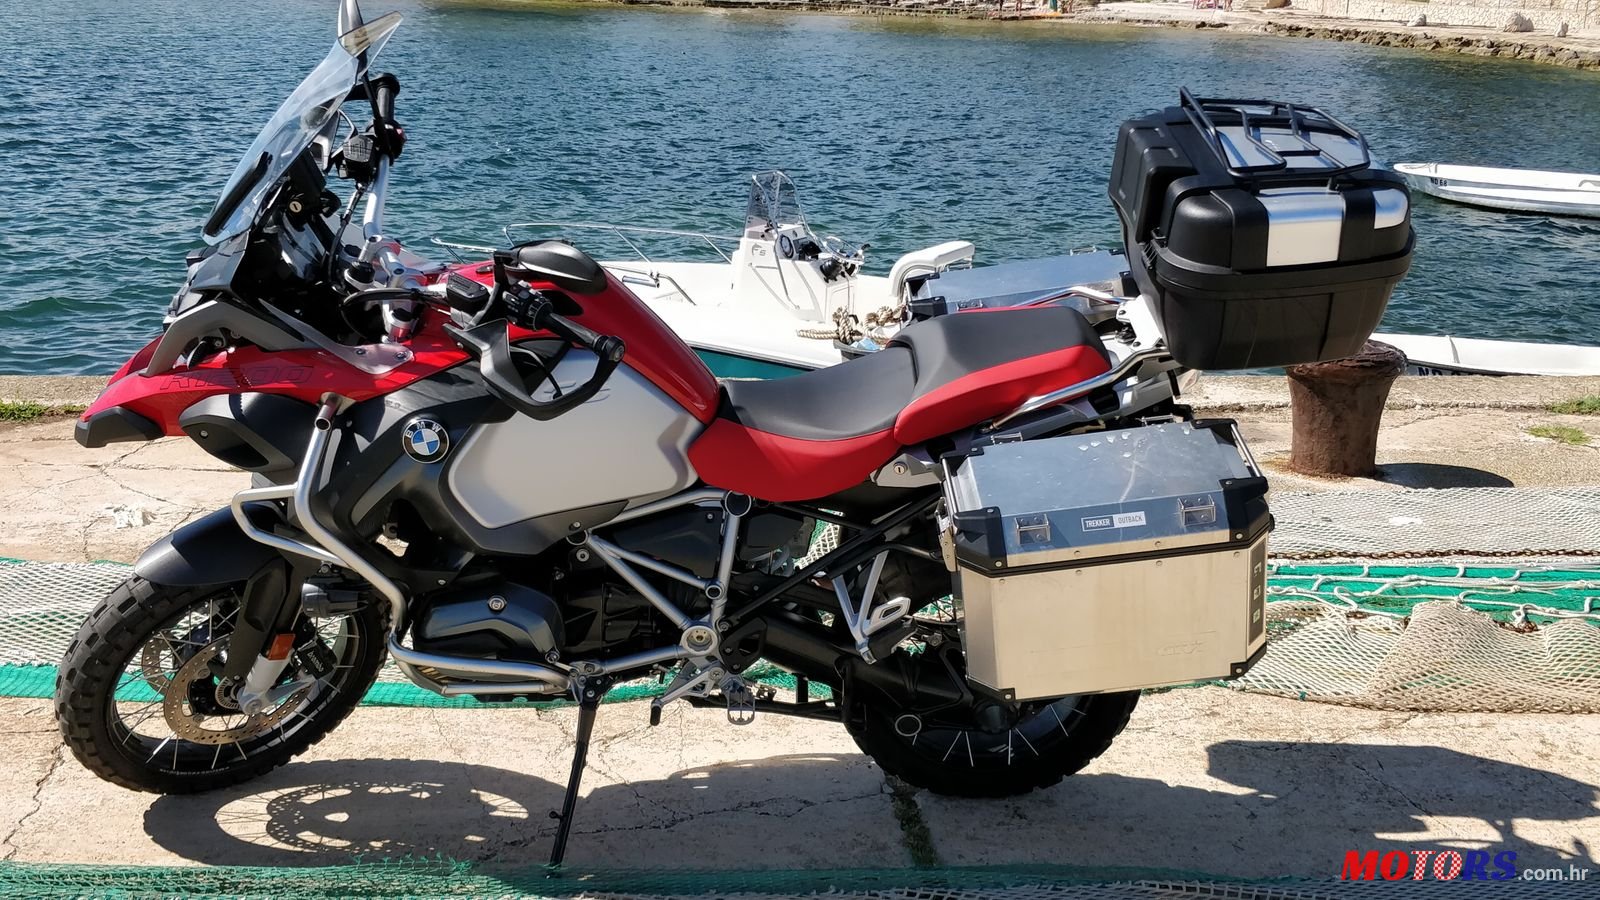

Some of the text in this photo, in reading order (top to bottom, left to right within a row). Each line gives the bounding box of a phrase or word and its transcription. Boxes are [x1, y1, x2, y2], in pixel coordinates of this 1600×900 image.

[405, 421, 442, 438] BMW
[1084, 515, 1143, 529] TREKKER OUTBACK
